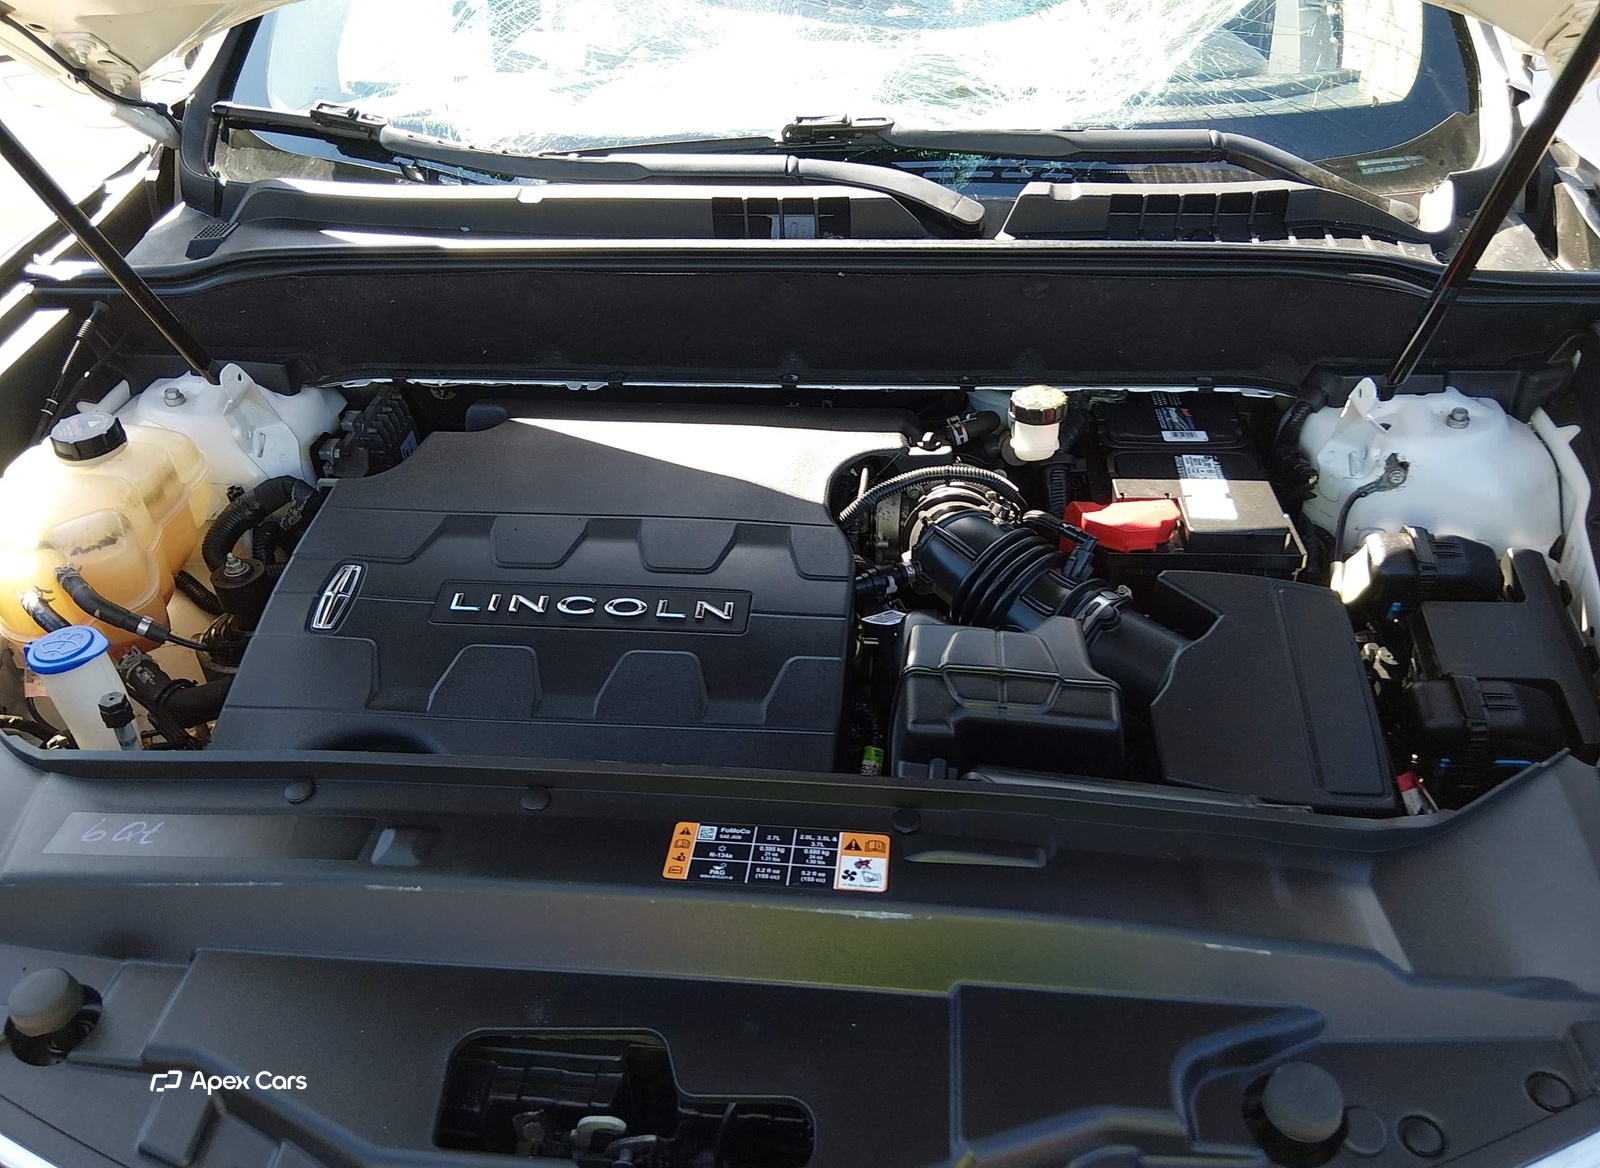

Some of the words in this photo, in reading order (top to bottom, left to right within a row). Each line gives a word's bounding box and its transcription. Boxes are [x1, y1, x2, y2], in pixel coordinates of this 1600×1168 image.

[450, 592, 735, 621] LINCOLN
[720, 827, 751, 835] FoMoCo
[709, 851, 733, 859] R-134a
[821, 849, 830, 857] kg
